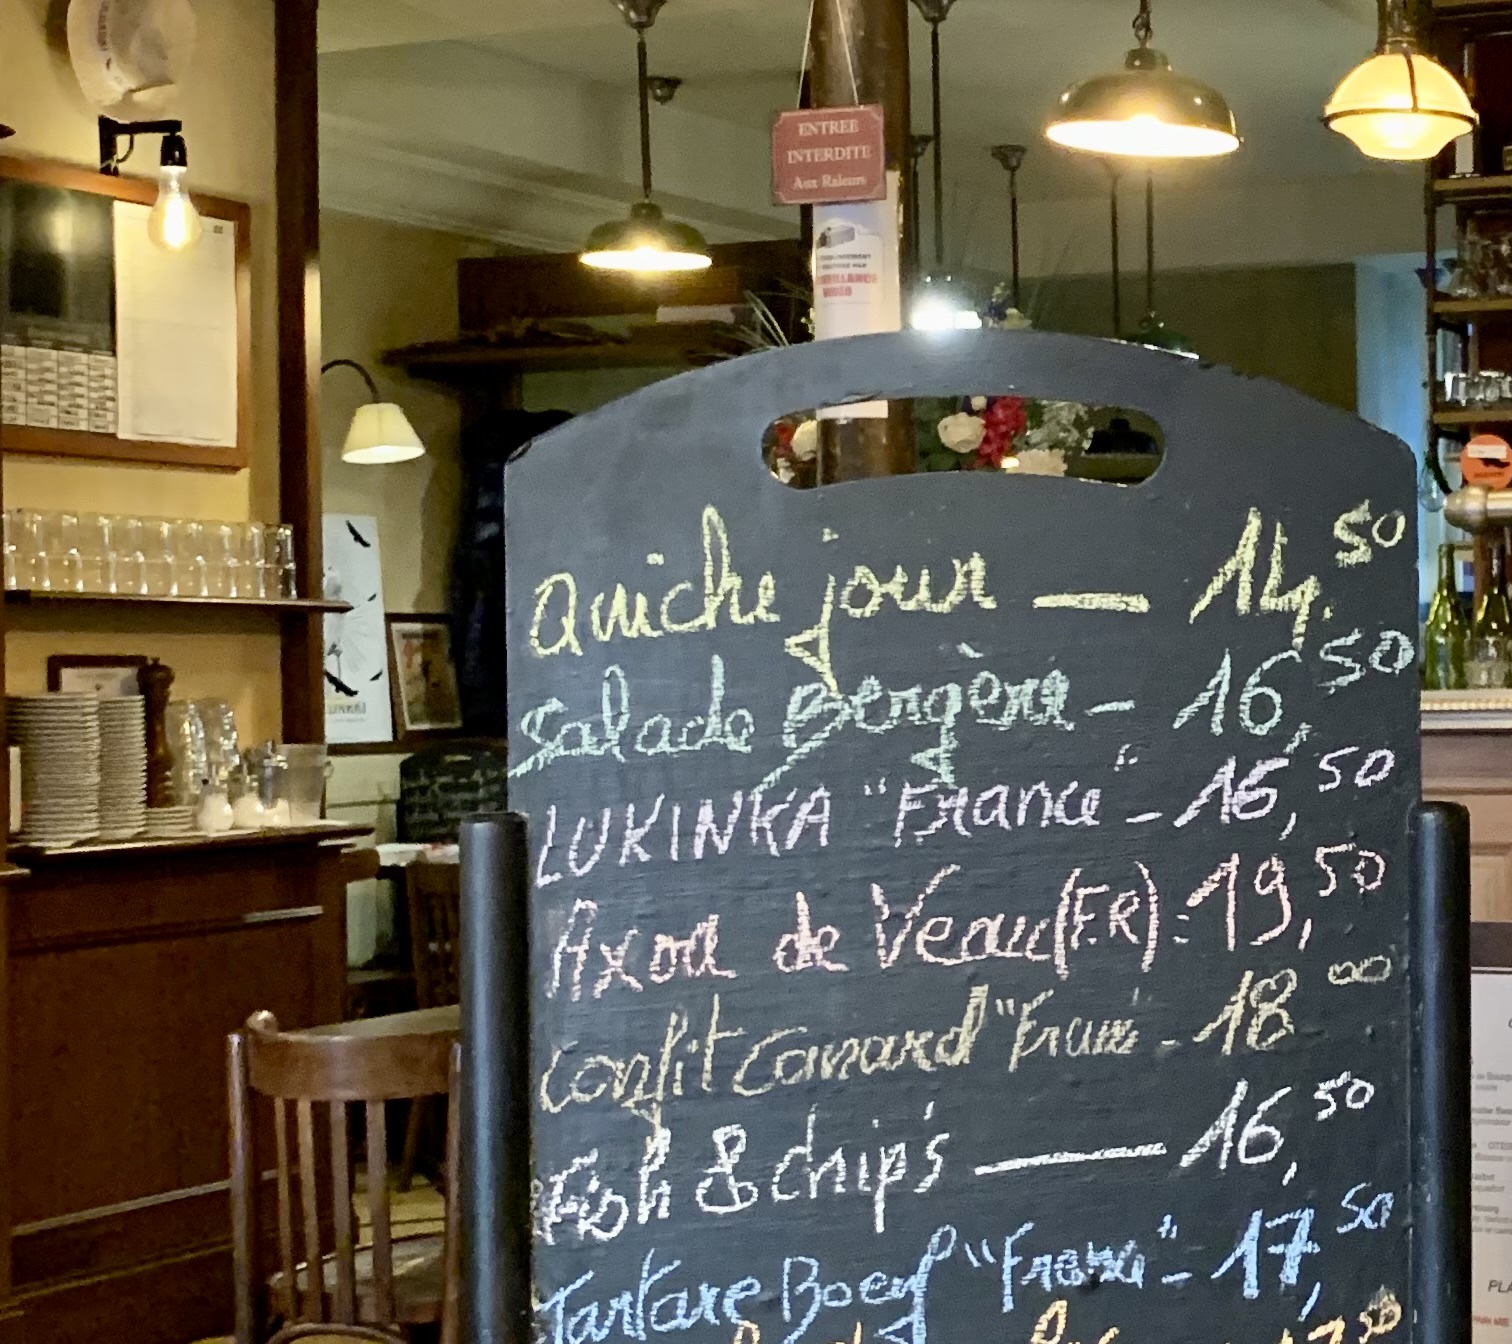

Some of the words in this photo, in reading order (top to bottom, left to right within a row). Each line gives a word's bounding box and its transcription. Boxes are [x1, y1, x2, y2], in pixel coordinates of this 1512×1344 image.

[787, 145, 873, 165] INTERDITE
[793, 176, 818, 191] Aux
[784, 527, 997, 697] jour
[536, 783, 831, 889] LUKINKA
[772, 890, 850, 973] de
[695, 1123, 758, 1214] &
